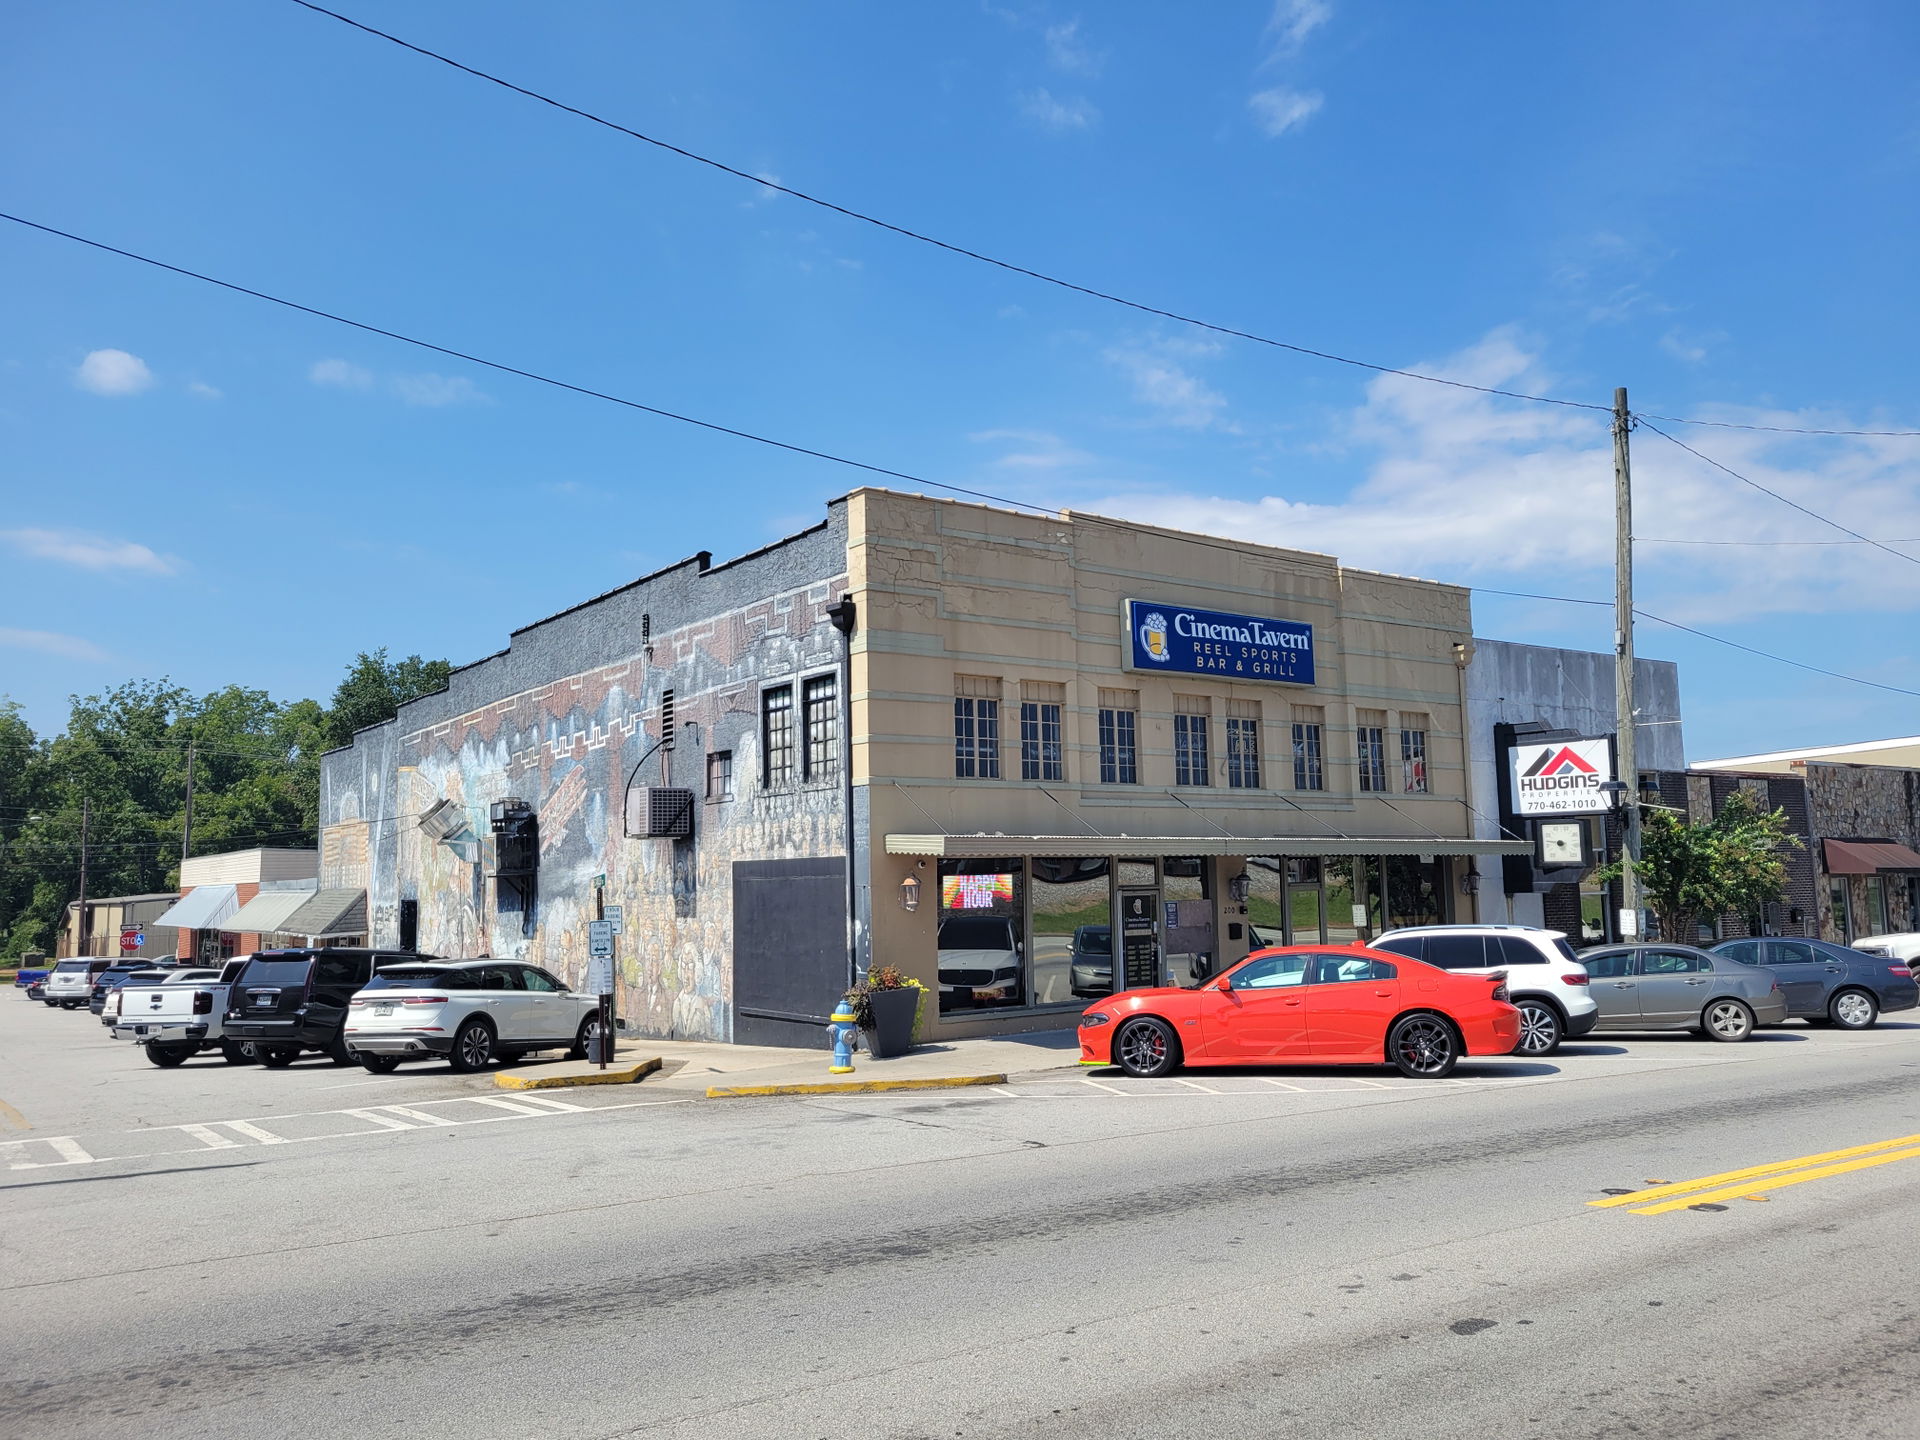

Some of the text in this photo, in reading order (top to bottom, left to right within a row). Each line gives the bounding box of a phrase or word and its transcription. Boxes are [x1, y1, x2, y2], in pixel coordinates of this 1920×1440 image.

[1193, 642, 1297, 664] REEL SPORTS
[1196, 656, 1295, 677] BAR & GRILL
[1521, 774, 1599, 791] HUDGINS
[1522, 789, 1600, 798] PROPERTIES
[1528, 799, 1596, 810] 770-462-1010
[960, 874, 997, 892] HAPPY
[963, 890, 994, 909] HOUR
[121, 937, 136, 945] STO
